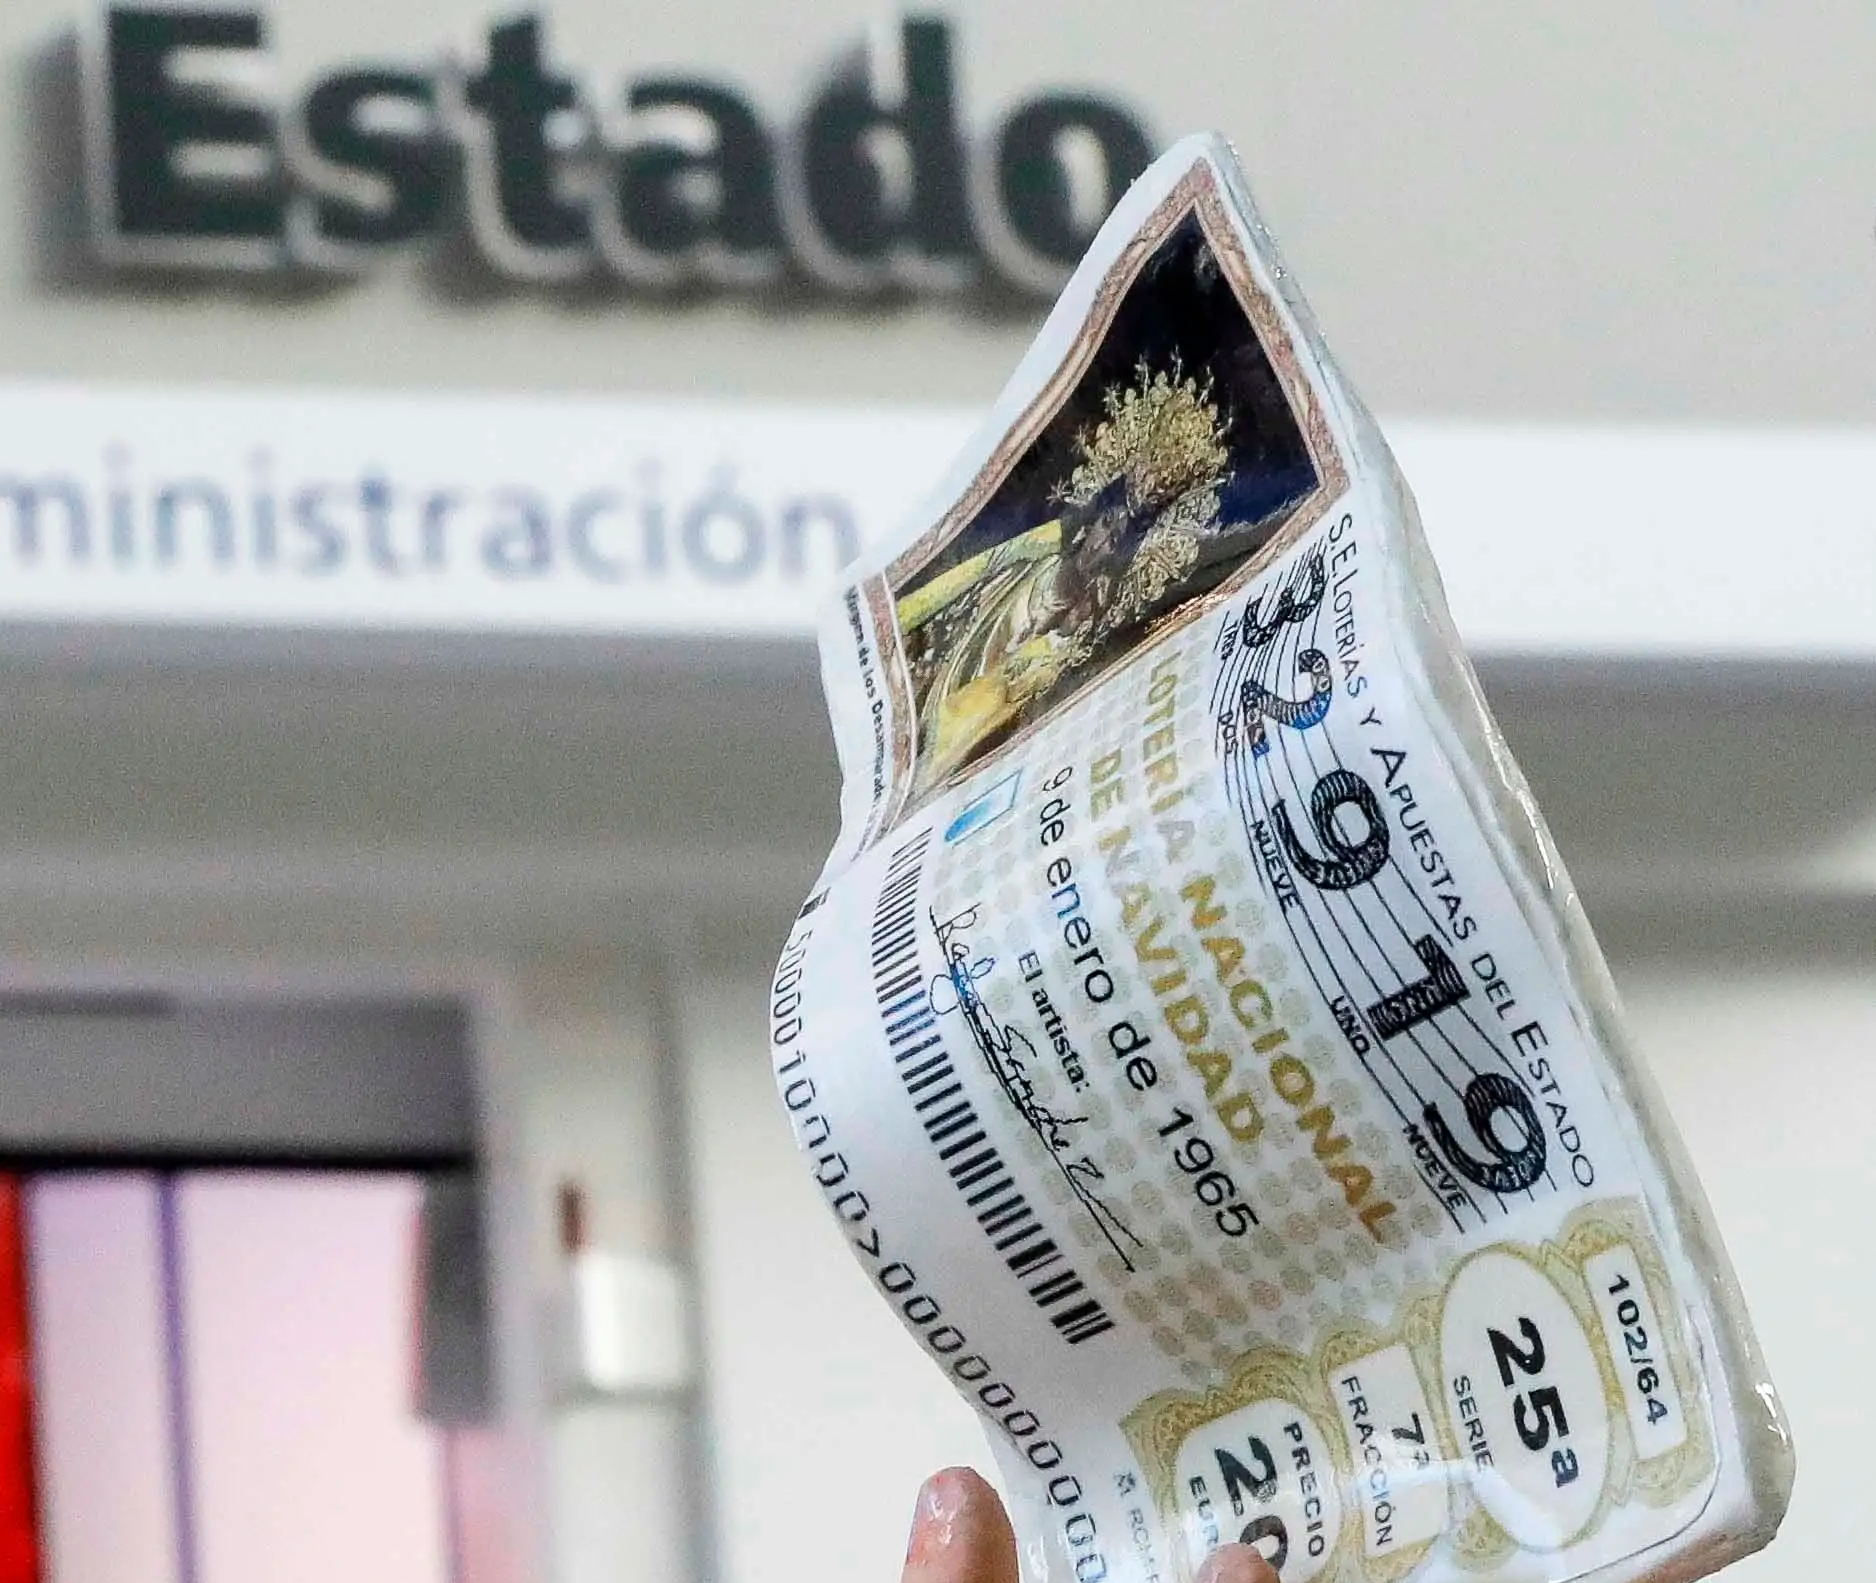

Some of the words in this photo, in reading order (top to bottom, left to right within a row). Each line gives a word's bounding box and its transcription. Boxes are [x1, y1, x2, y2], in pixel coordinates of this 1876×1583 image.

[96, 8, 1160, 278] Estado
[1358, 706, 1383, 728] Y
[1039, 803, 1071, 847] de
[1370, 745, 1478, 941] APUESTAS
[1018, 950, 1043, 984] El
[1045, 856, 1115, 1004] enero
[1097, 825, 1264, 1143] NAVIDAD
[1470, 953, 1518, 1020] DEL
[1108, 1022, 1158, 1091] de
[1180, 875, 1397, 1245] NACIONAL
[1250, 818, 1301, 910] NUEVE
[1403, 1123, 1467, 1210] NUEVE
[1157, 1106, 1260, 1238] 1965
[1510, 1020, 1595, 1188] ESTADO
[1453, 1375, 1495, 1472] SERIE
[1607, 1274, 1668, 1426] 102/64
[1283, 1421, 1325, 1558] PRECIO
[1341, 1375, 1396, 1547] FRACCIÓN
